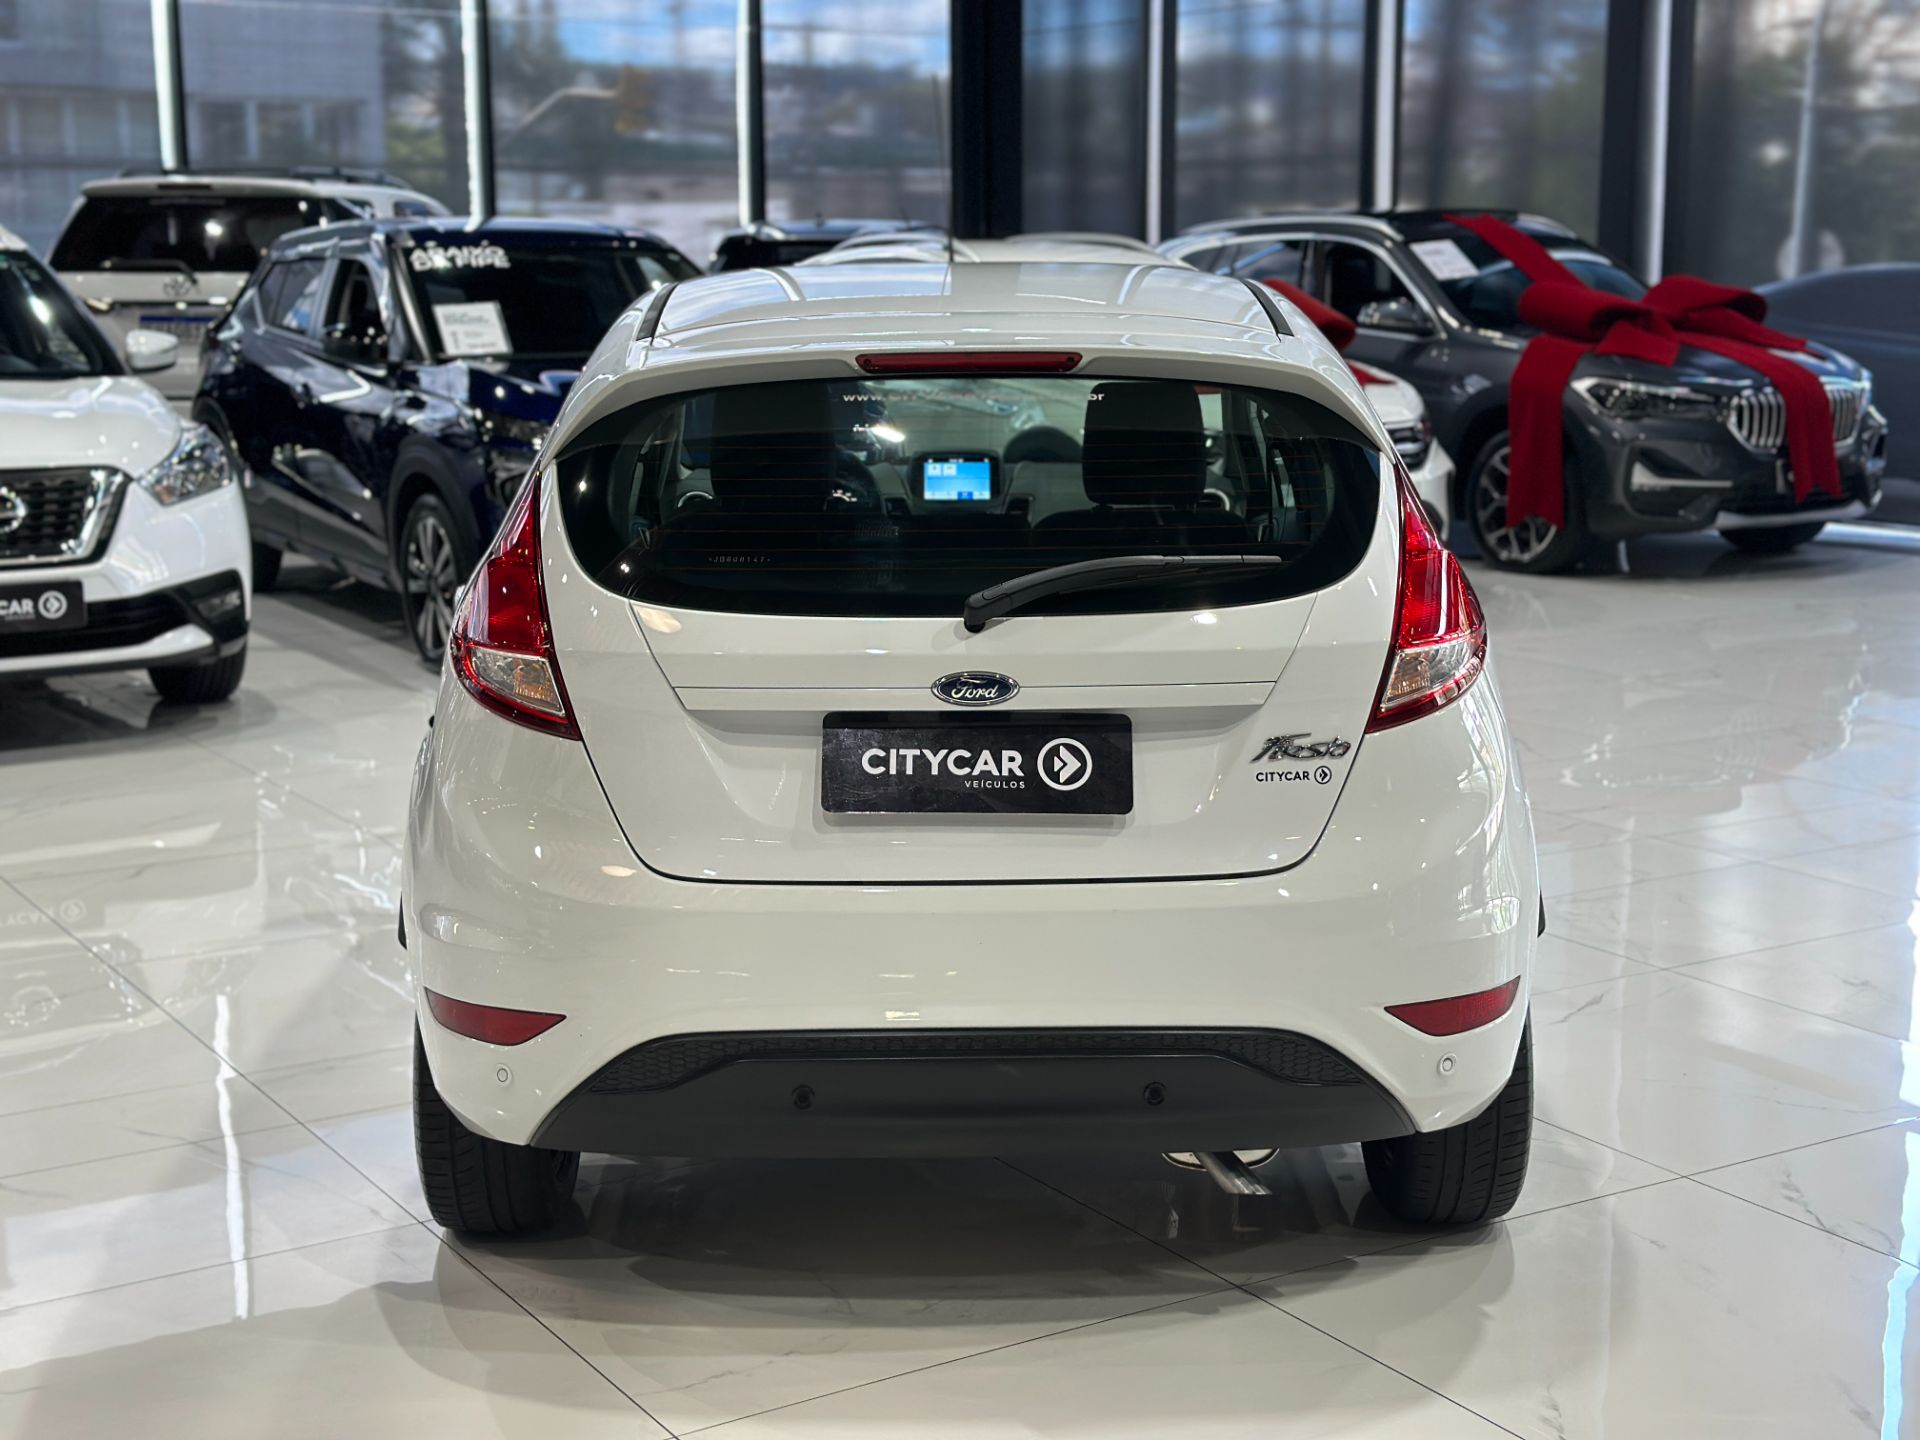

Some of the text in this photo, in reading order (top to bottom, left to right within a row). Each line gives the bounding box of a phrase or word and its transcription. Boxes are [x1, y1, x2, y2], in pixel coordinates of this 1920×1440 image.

[951, 676, 999, 699] Ford
[861, 748, 1025, 777] CITYCAR
[964, 779, 1025, 789] VEÍCULOS
[1255, 771, 1310, 782] CITYCAR
